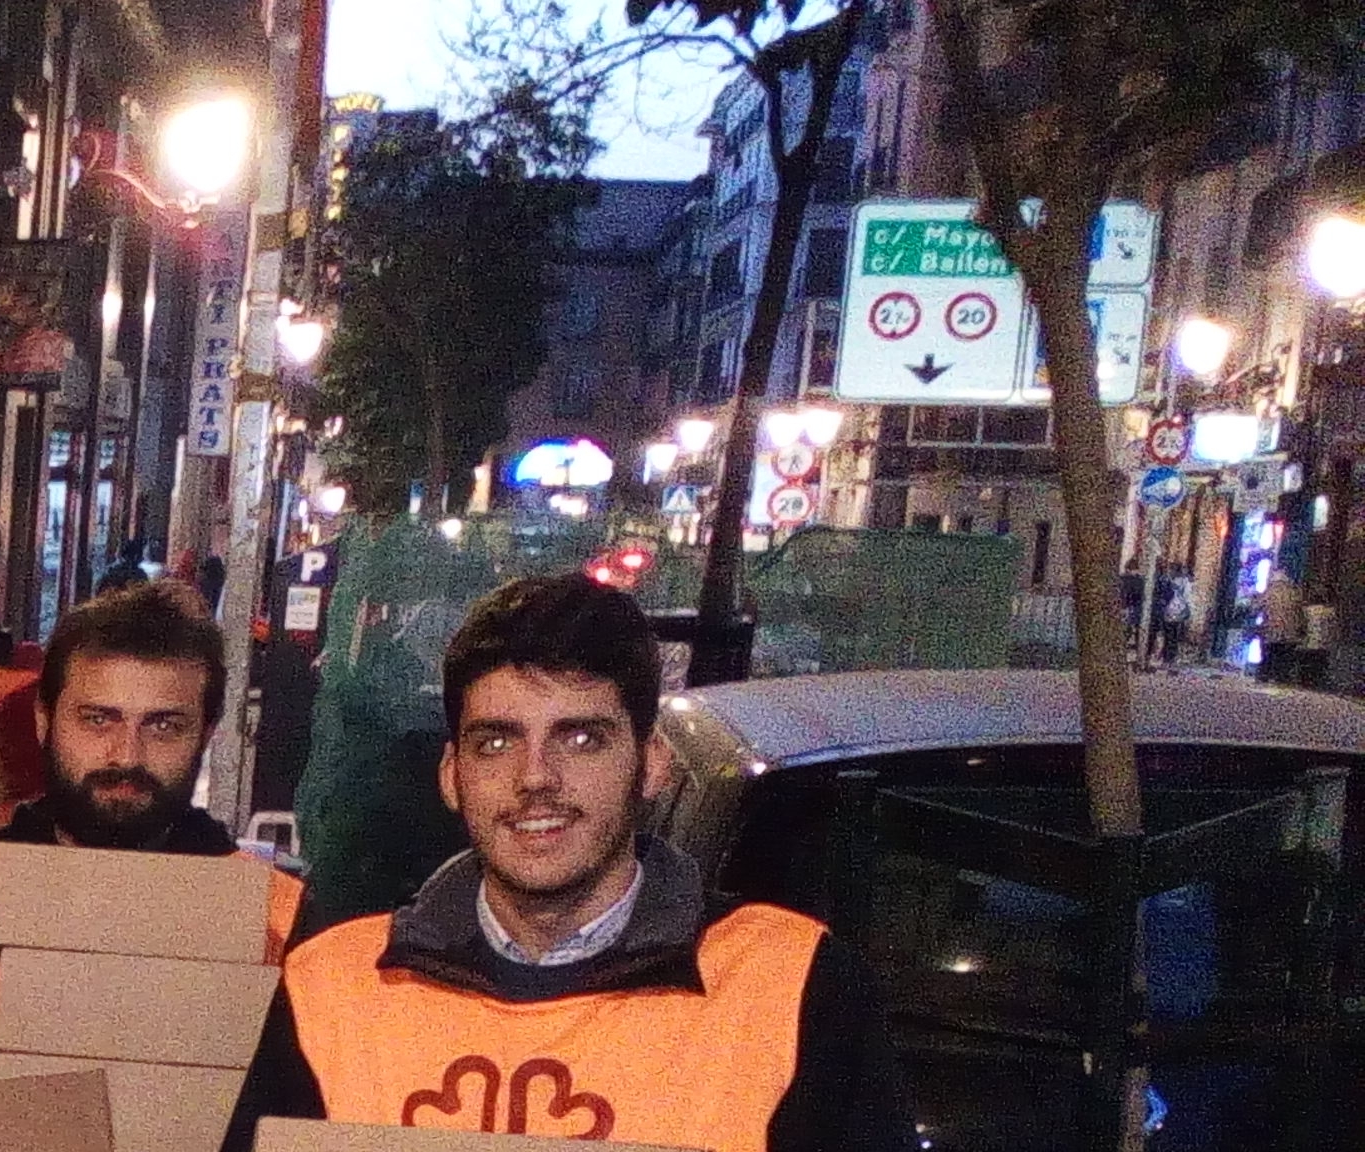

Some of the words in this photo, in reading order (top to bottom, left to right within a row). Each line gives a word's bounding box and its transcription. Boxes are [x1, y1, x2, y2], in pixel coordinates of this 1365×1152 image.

[923, 222, 996, 251] Mayo
[957, 308, 986, 325] 20
[198, 337, 230, 448] PRATS
[301, 551, 328, 582] P
